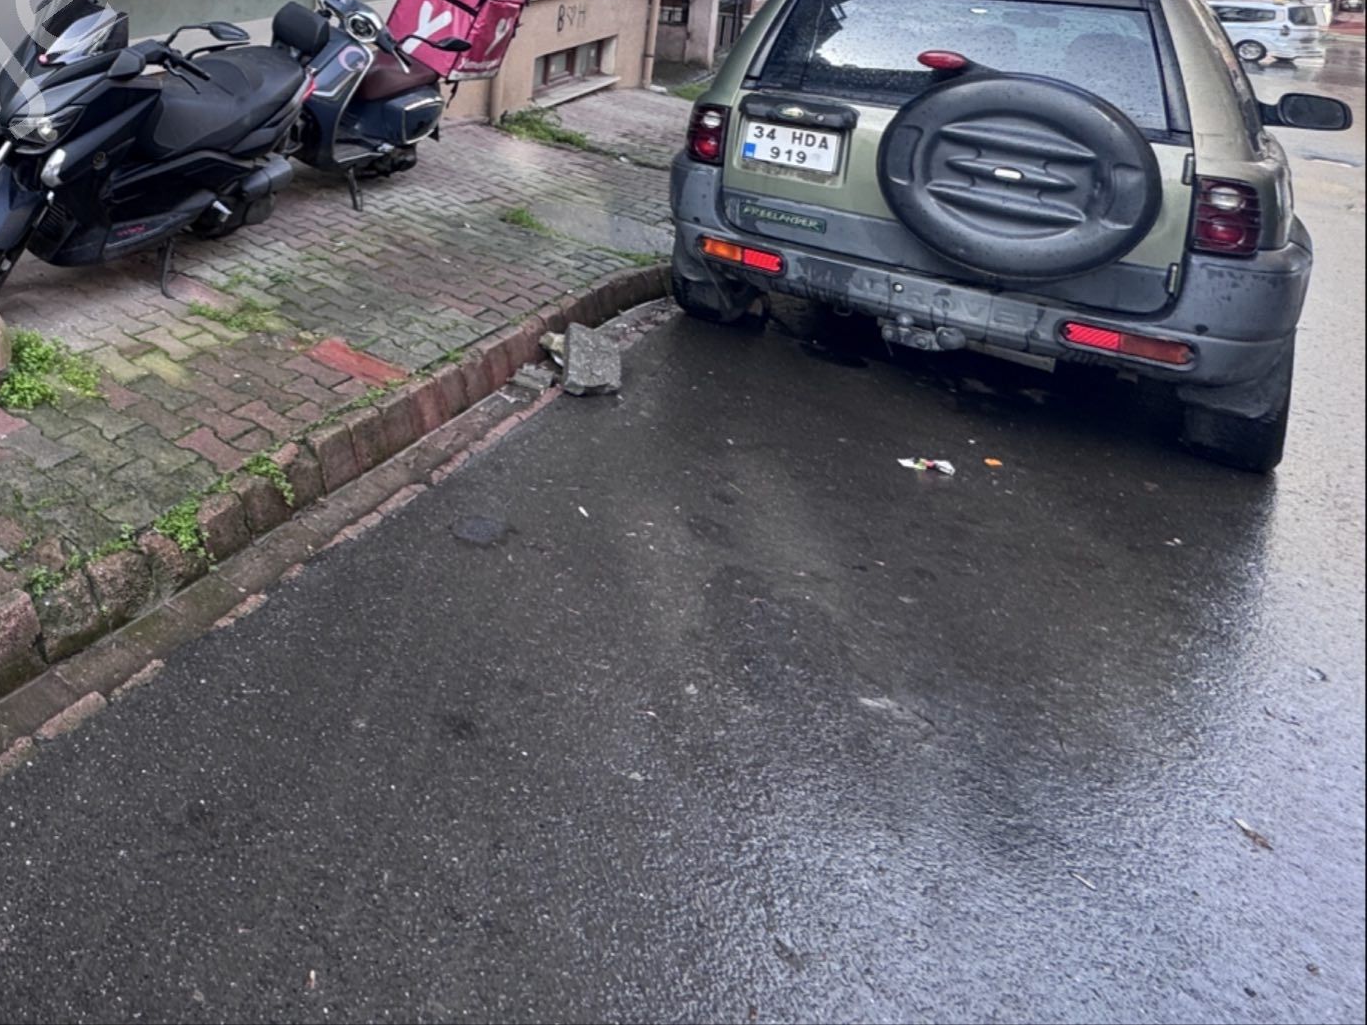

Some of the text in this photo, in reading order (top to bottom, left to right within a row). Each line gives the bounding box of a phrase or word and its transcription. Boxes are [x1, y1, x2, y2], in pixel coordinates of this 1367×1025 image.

[753, 126, 829, 150] 34 HDA
[770, 146, 807, 164] 919
